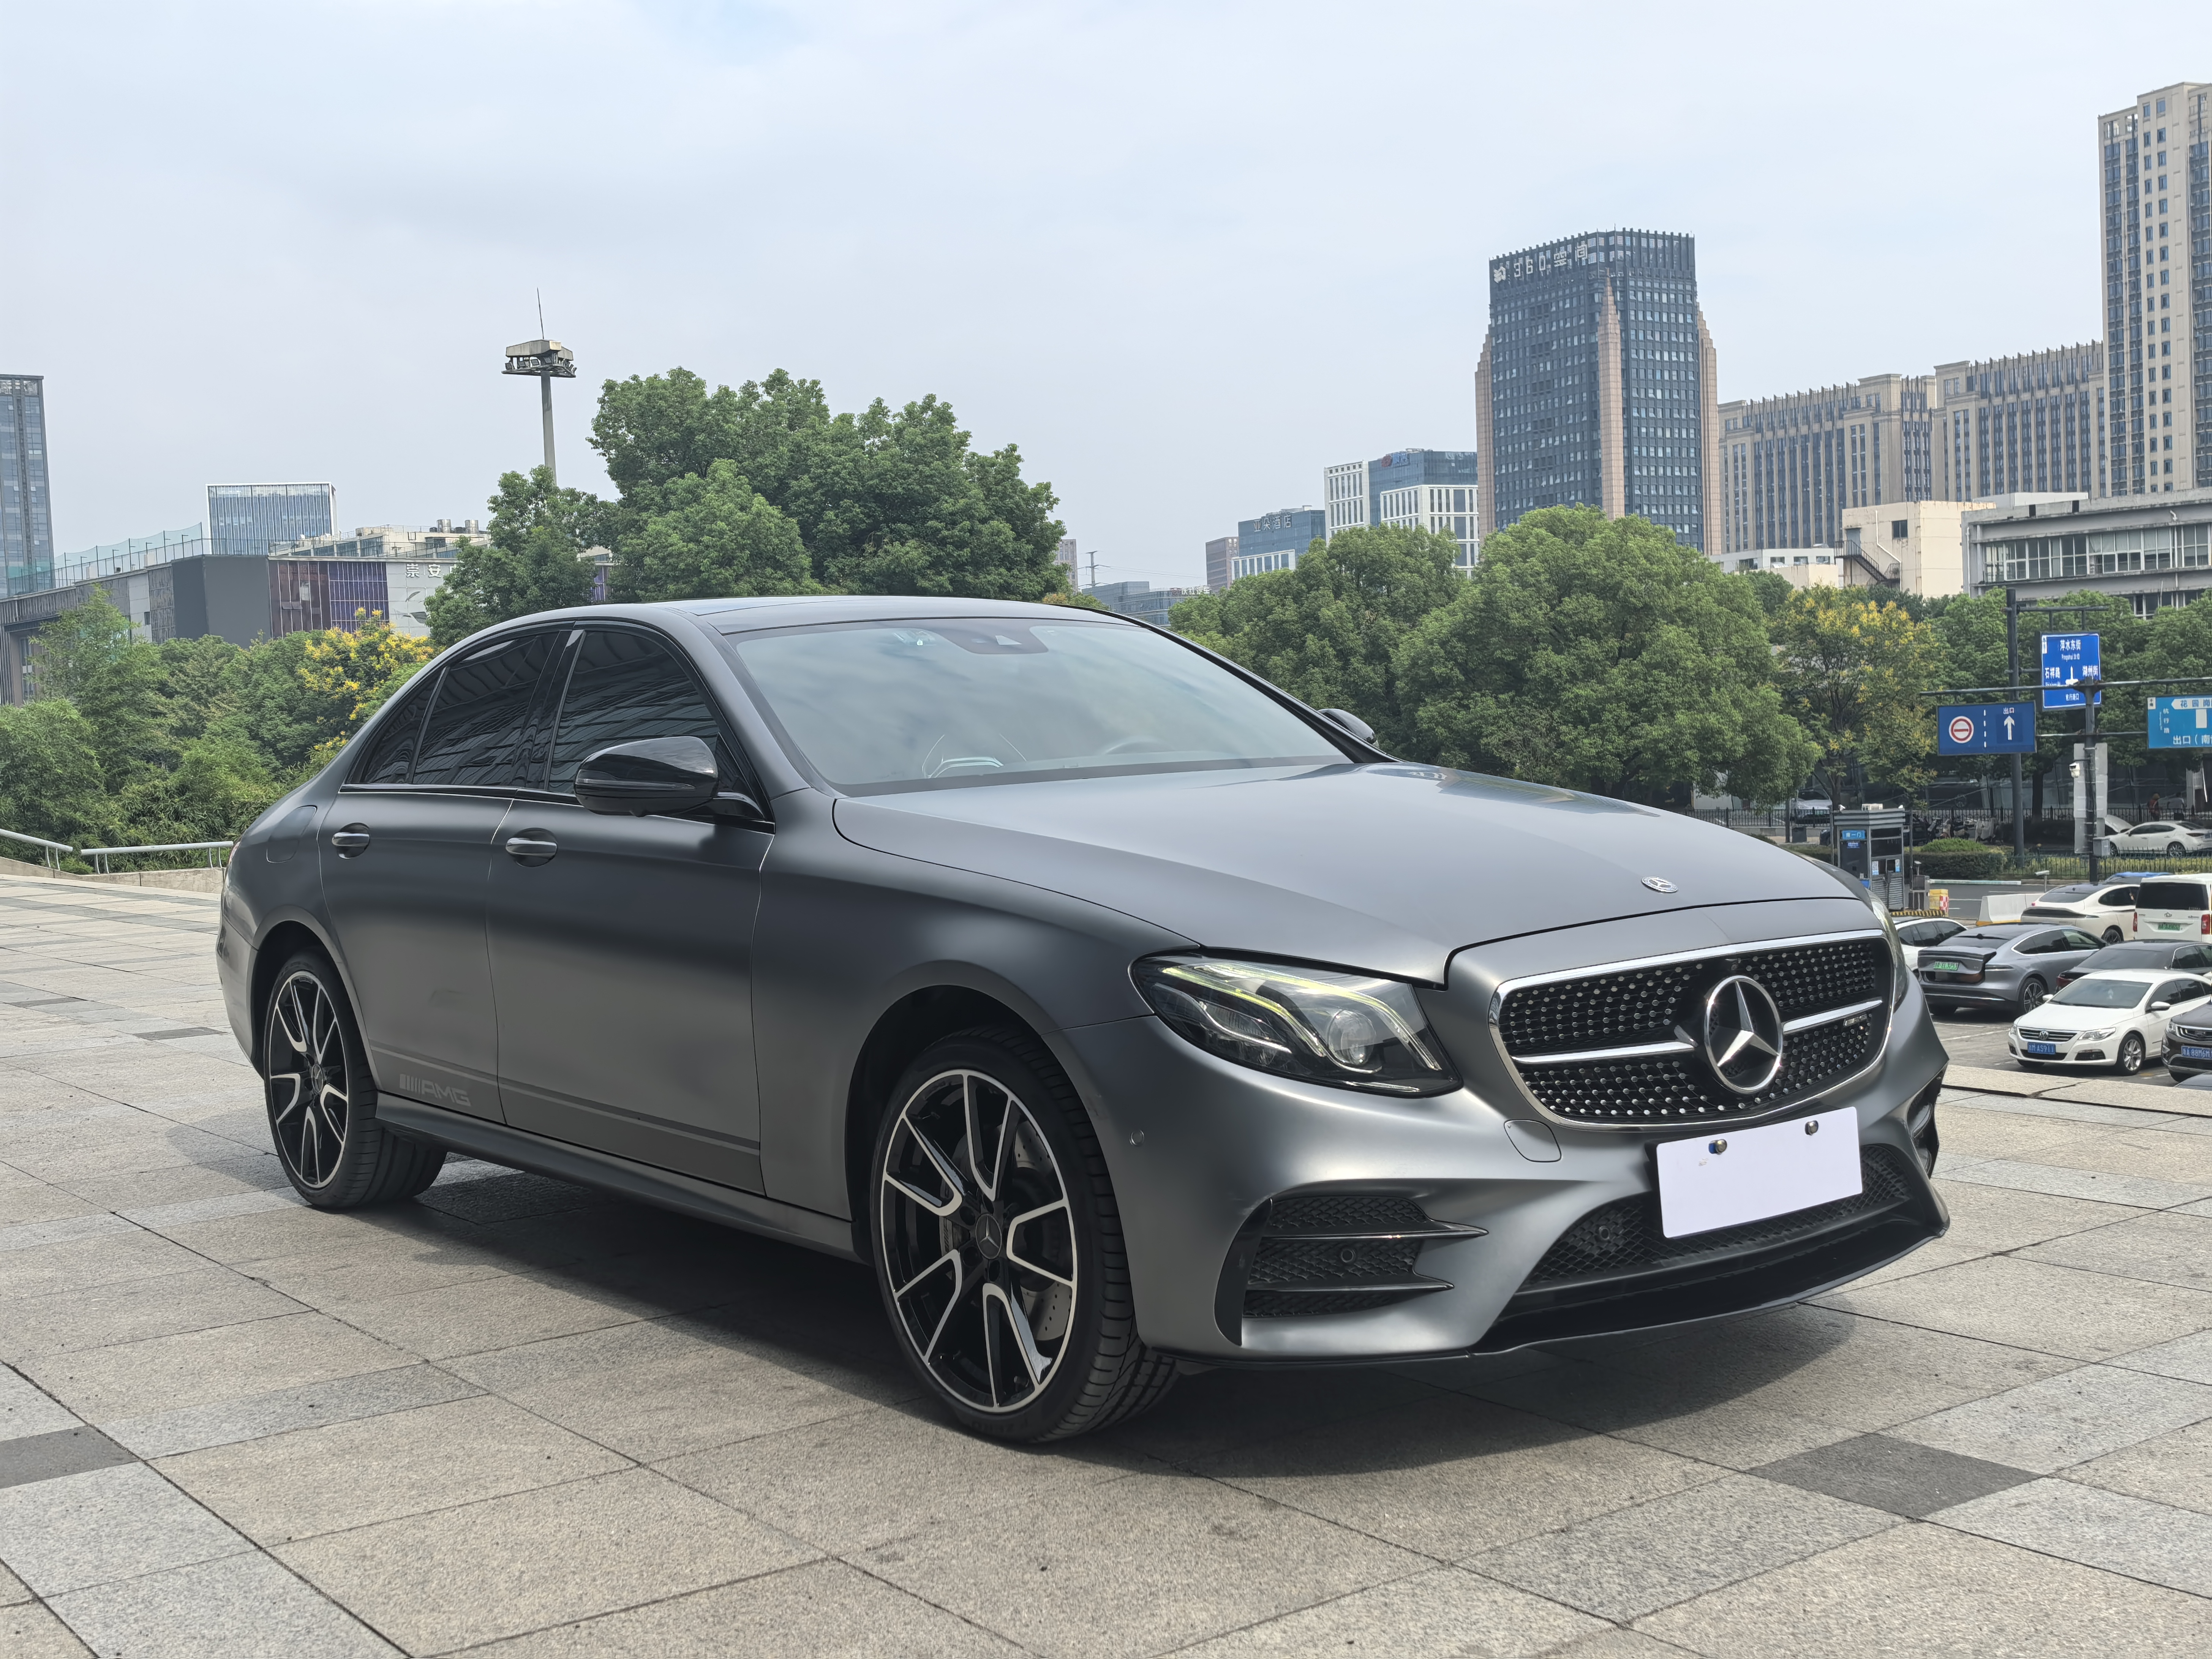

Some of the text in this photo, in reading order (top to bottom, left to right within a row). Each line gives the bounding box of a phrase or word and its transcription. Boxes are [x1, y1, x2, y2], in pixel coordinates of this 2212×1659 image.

[1254, 513, 1291, 532] 亚朵酒店
[2060, 639, 2081, 651] 萍水东街
[2180, 699, 2212, 708] 花园岗
[2173, 734, 2212, 745] 出口（南
